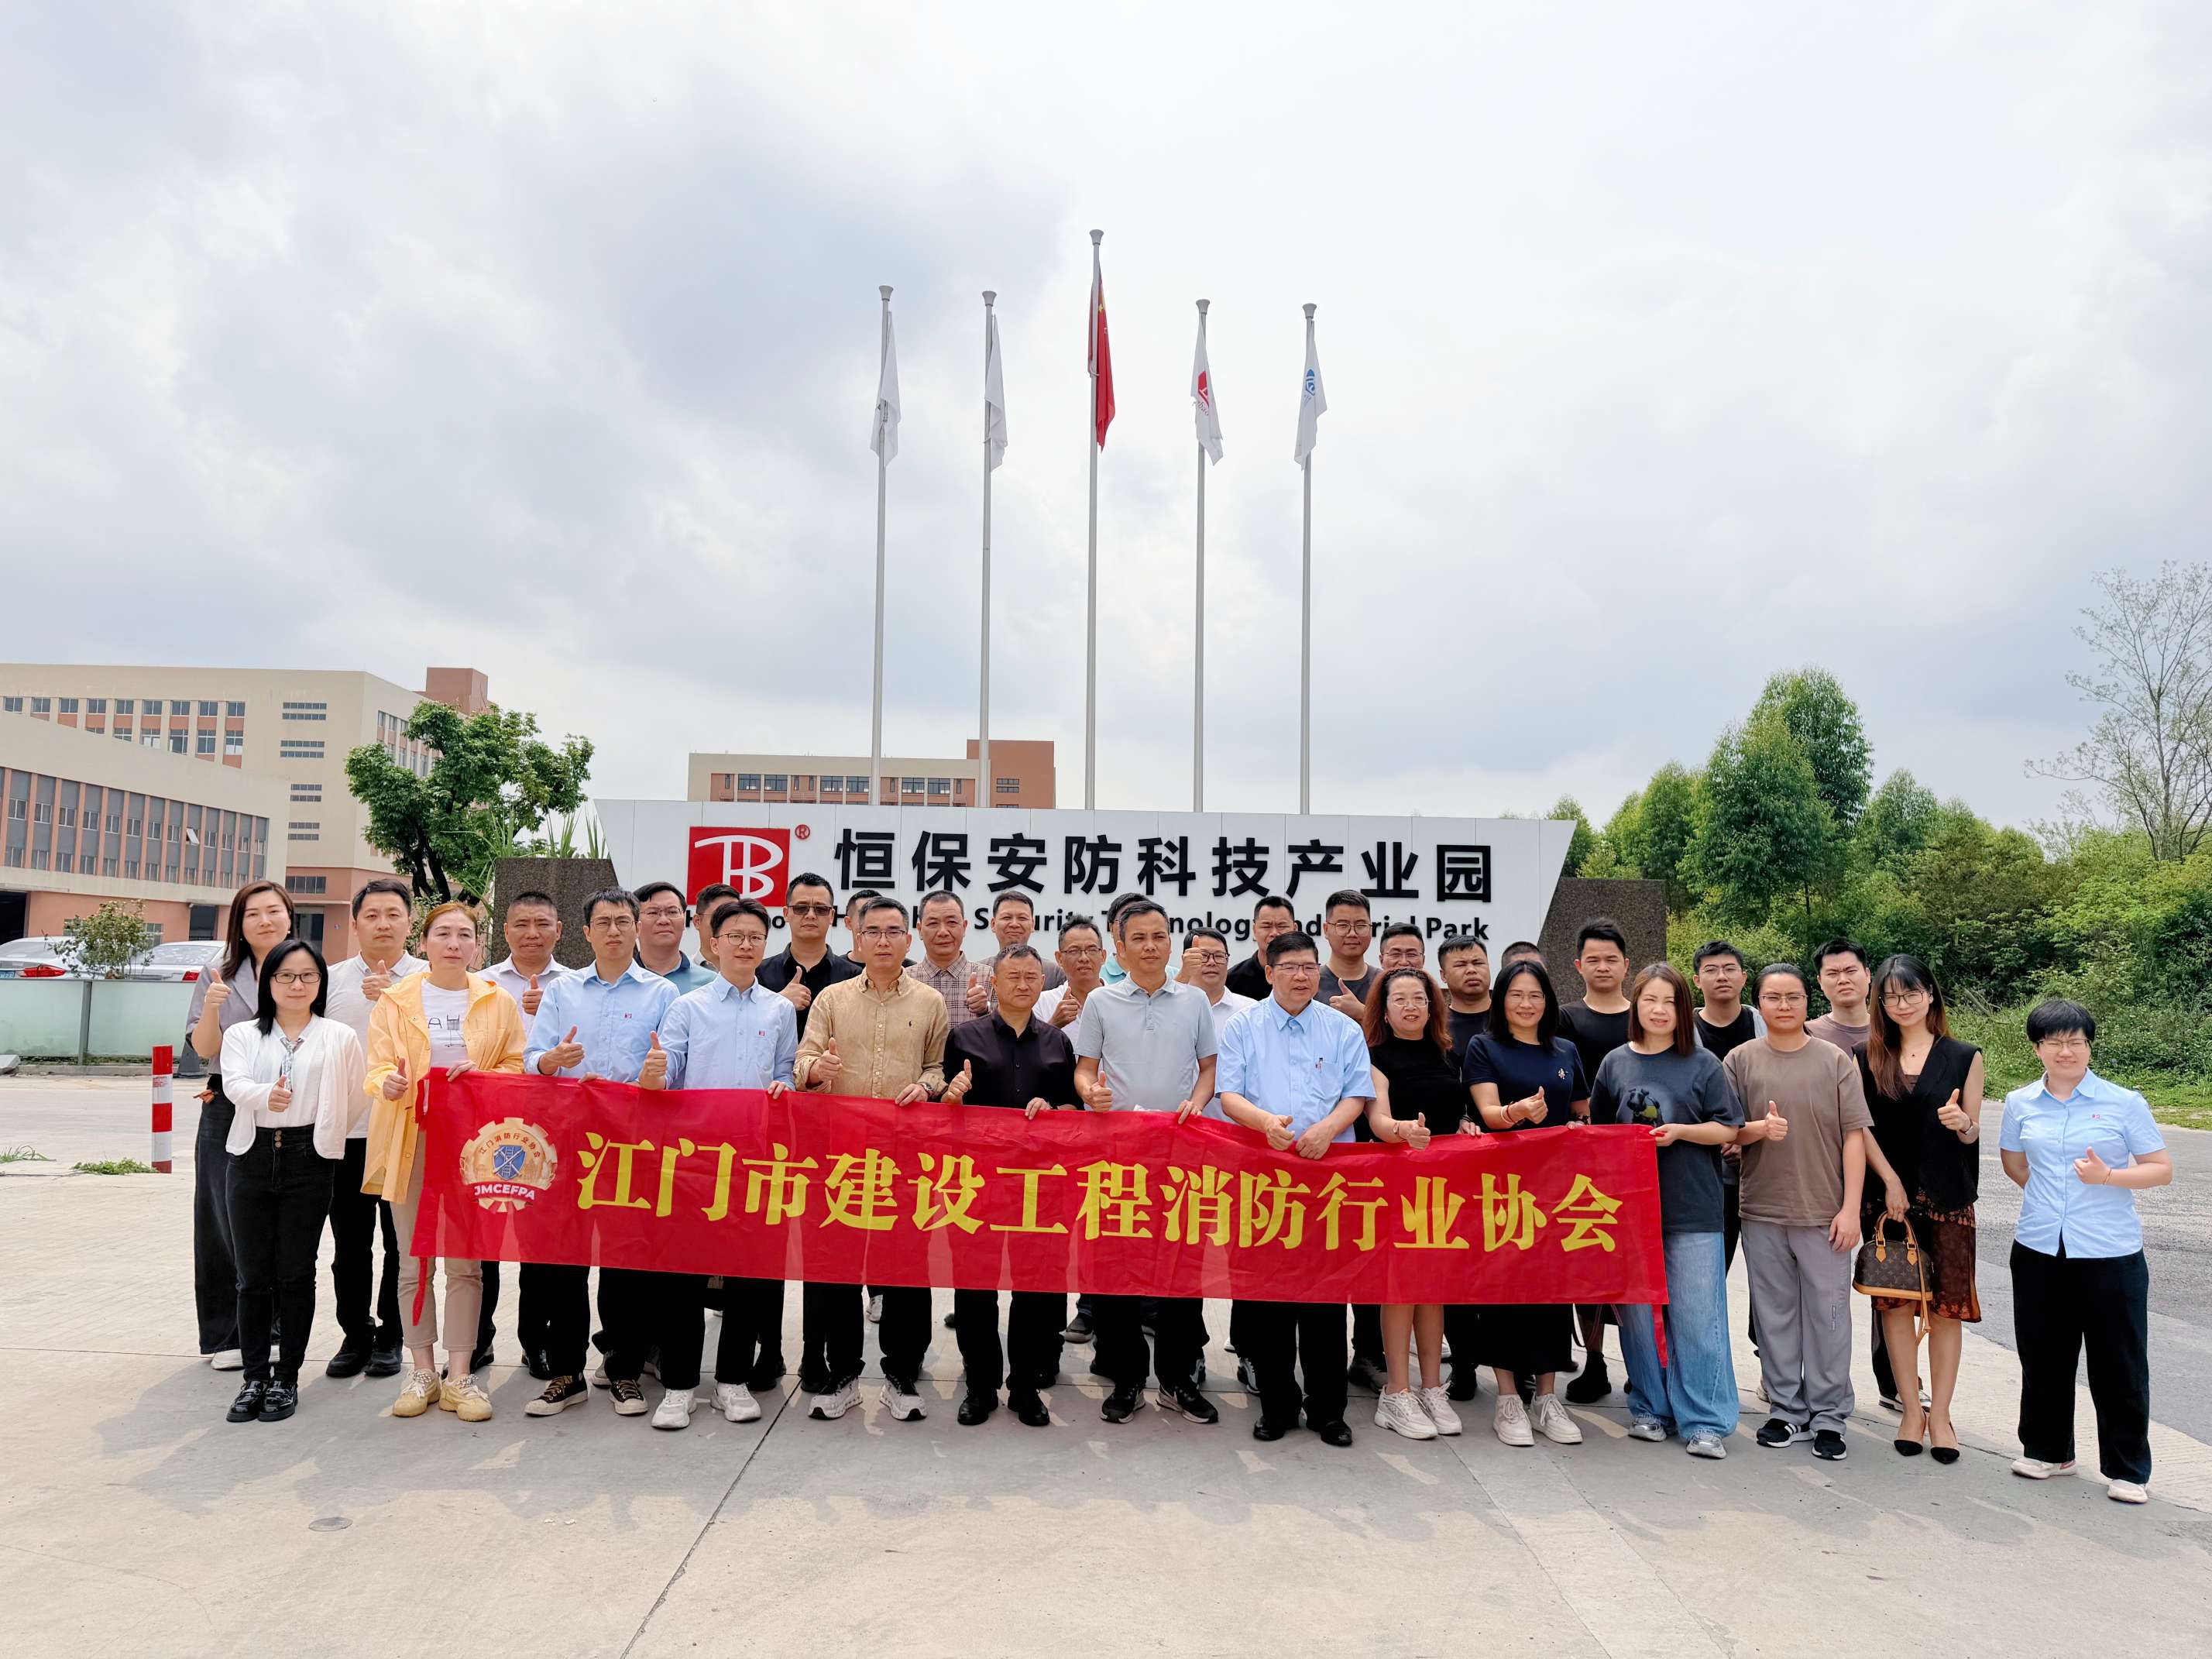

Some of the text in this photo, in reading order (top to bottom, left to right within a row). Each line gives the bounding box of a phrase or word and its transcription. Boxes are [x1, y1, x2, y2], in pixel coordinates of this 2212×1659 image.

[833, 828, 1492, 903] 恒保安防科技产业园
[1426, 916, 1489, 940] Park
[479, 1132, 541, 1158] 江门消防行业协会
[474, 1183, 535, 1200] JMCEFPA
[577, 1131, 1622, 1253] 江门市建设工程消防行业协会
